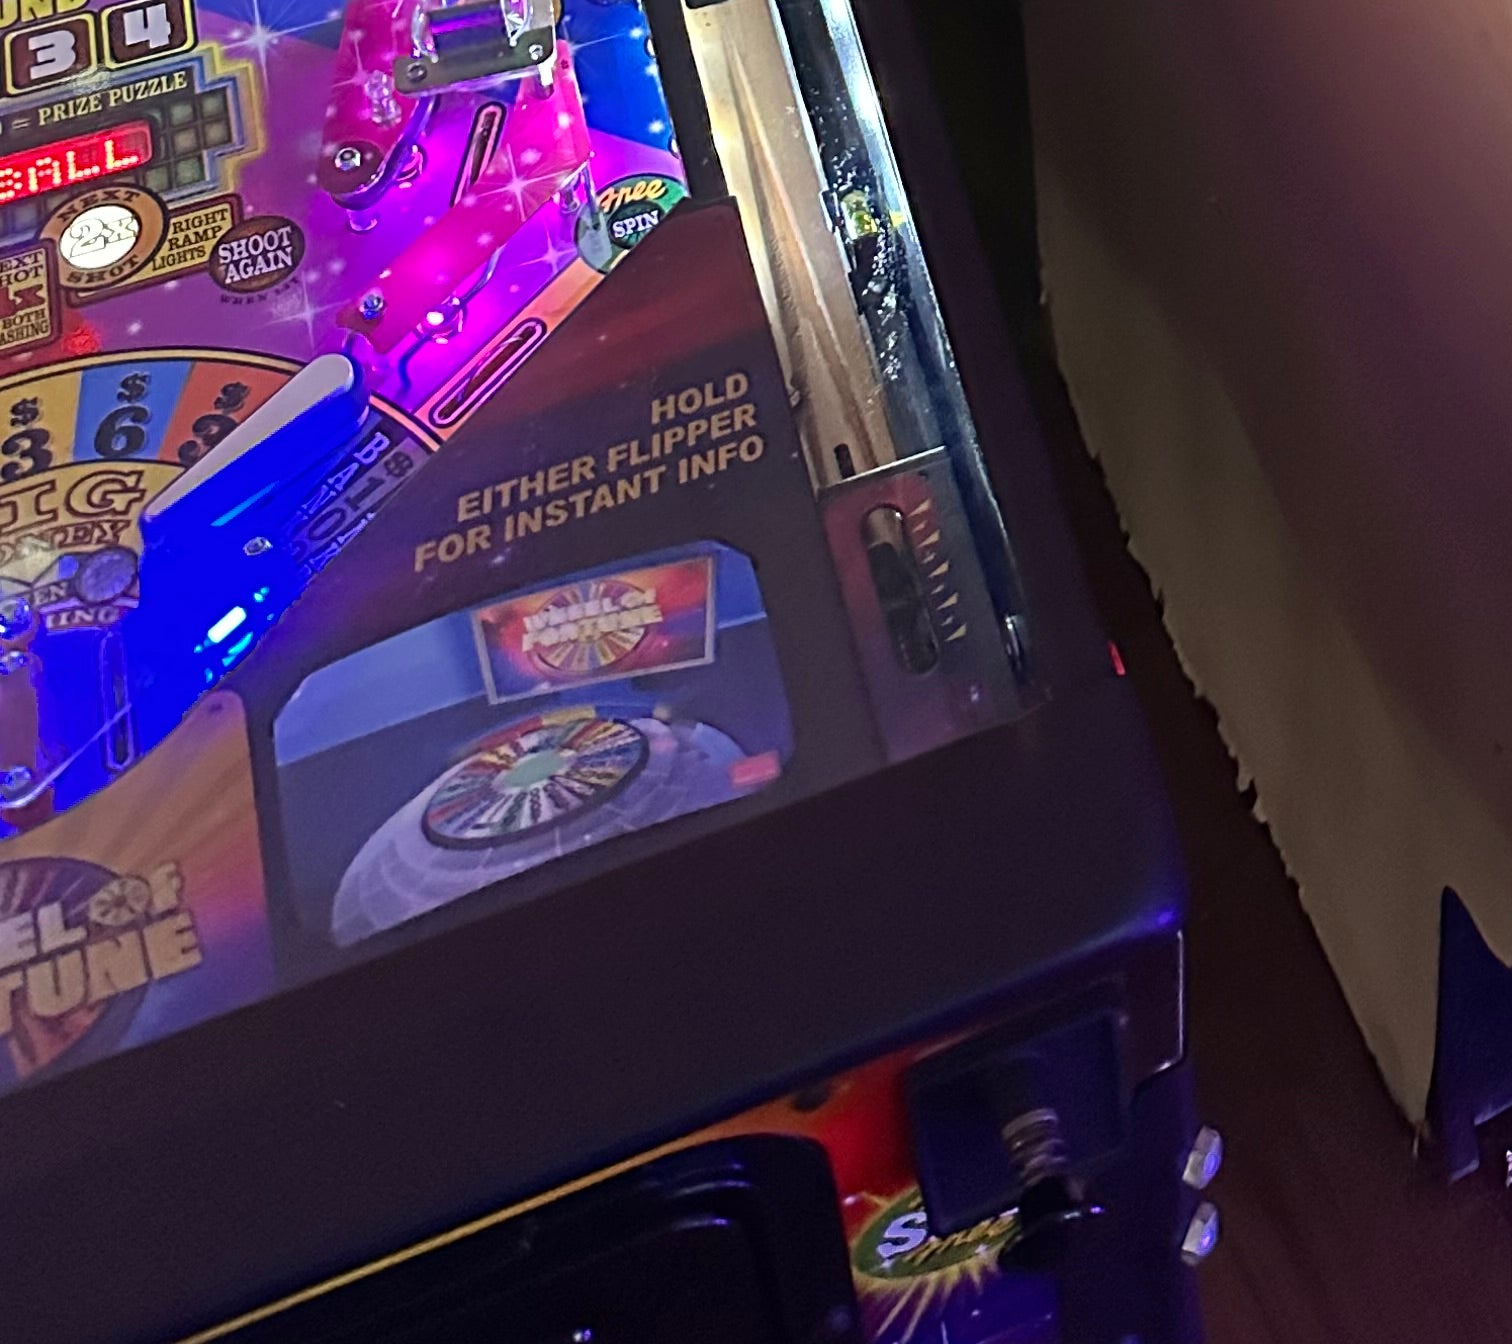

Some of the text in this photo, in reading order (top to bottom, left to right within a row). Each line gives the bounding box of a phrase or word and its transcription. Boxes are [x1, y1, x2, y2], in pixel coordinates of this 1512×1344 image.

[123, 2, 173, 50] 4
[28, 29, 77, 80] 3
[38, 92, 103, 127] PRIZE
[108, 70, 188, 108] PUZZLE
[57, 188, 142, 222] NEXT
[171, 208, 229, 236] RIGHT
[167, 225, 223, 252] RAMP
[612, 209, 661, 239] SPIN
[0, 251, 44, 273] EXT
[151, 246, 207, 272] LIGHTS
[218, 226, 293, 265] SHOOT
[0, 264, 44, 286] HOT
[65, 253, 140, 285] SHOT
[224, 247, 294, 285] AGAIN
[0, 319, 49, 346] ASHING
[2, 307, 46, 330] BOTH
[213, 381, 252, 413] $
[650, 372, 750, 425] HOLD
[94, 372, 152, 459] $ 6
[1, 395, 54, 484] $ 3
[456, 402, 758, 524] EITHER FLIPPER
[0, 470, 147, 534] IG
[413, 523, 492, 574] FOR
[503, 464, 667, 543] INSTANT
[677, 434, 766, 484] INFO
